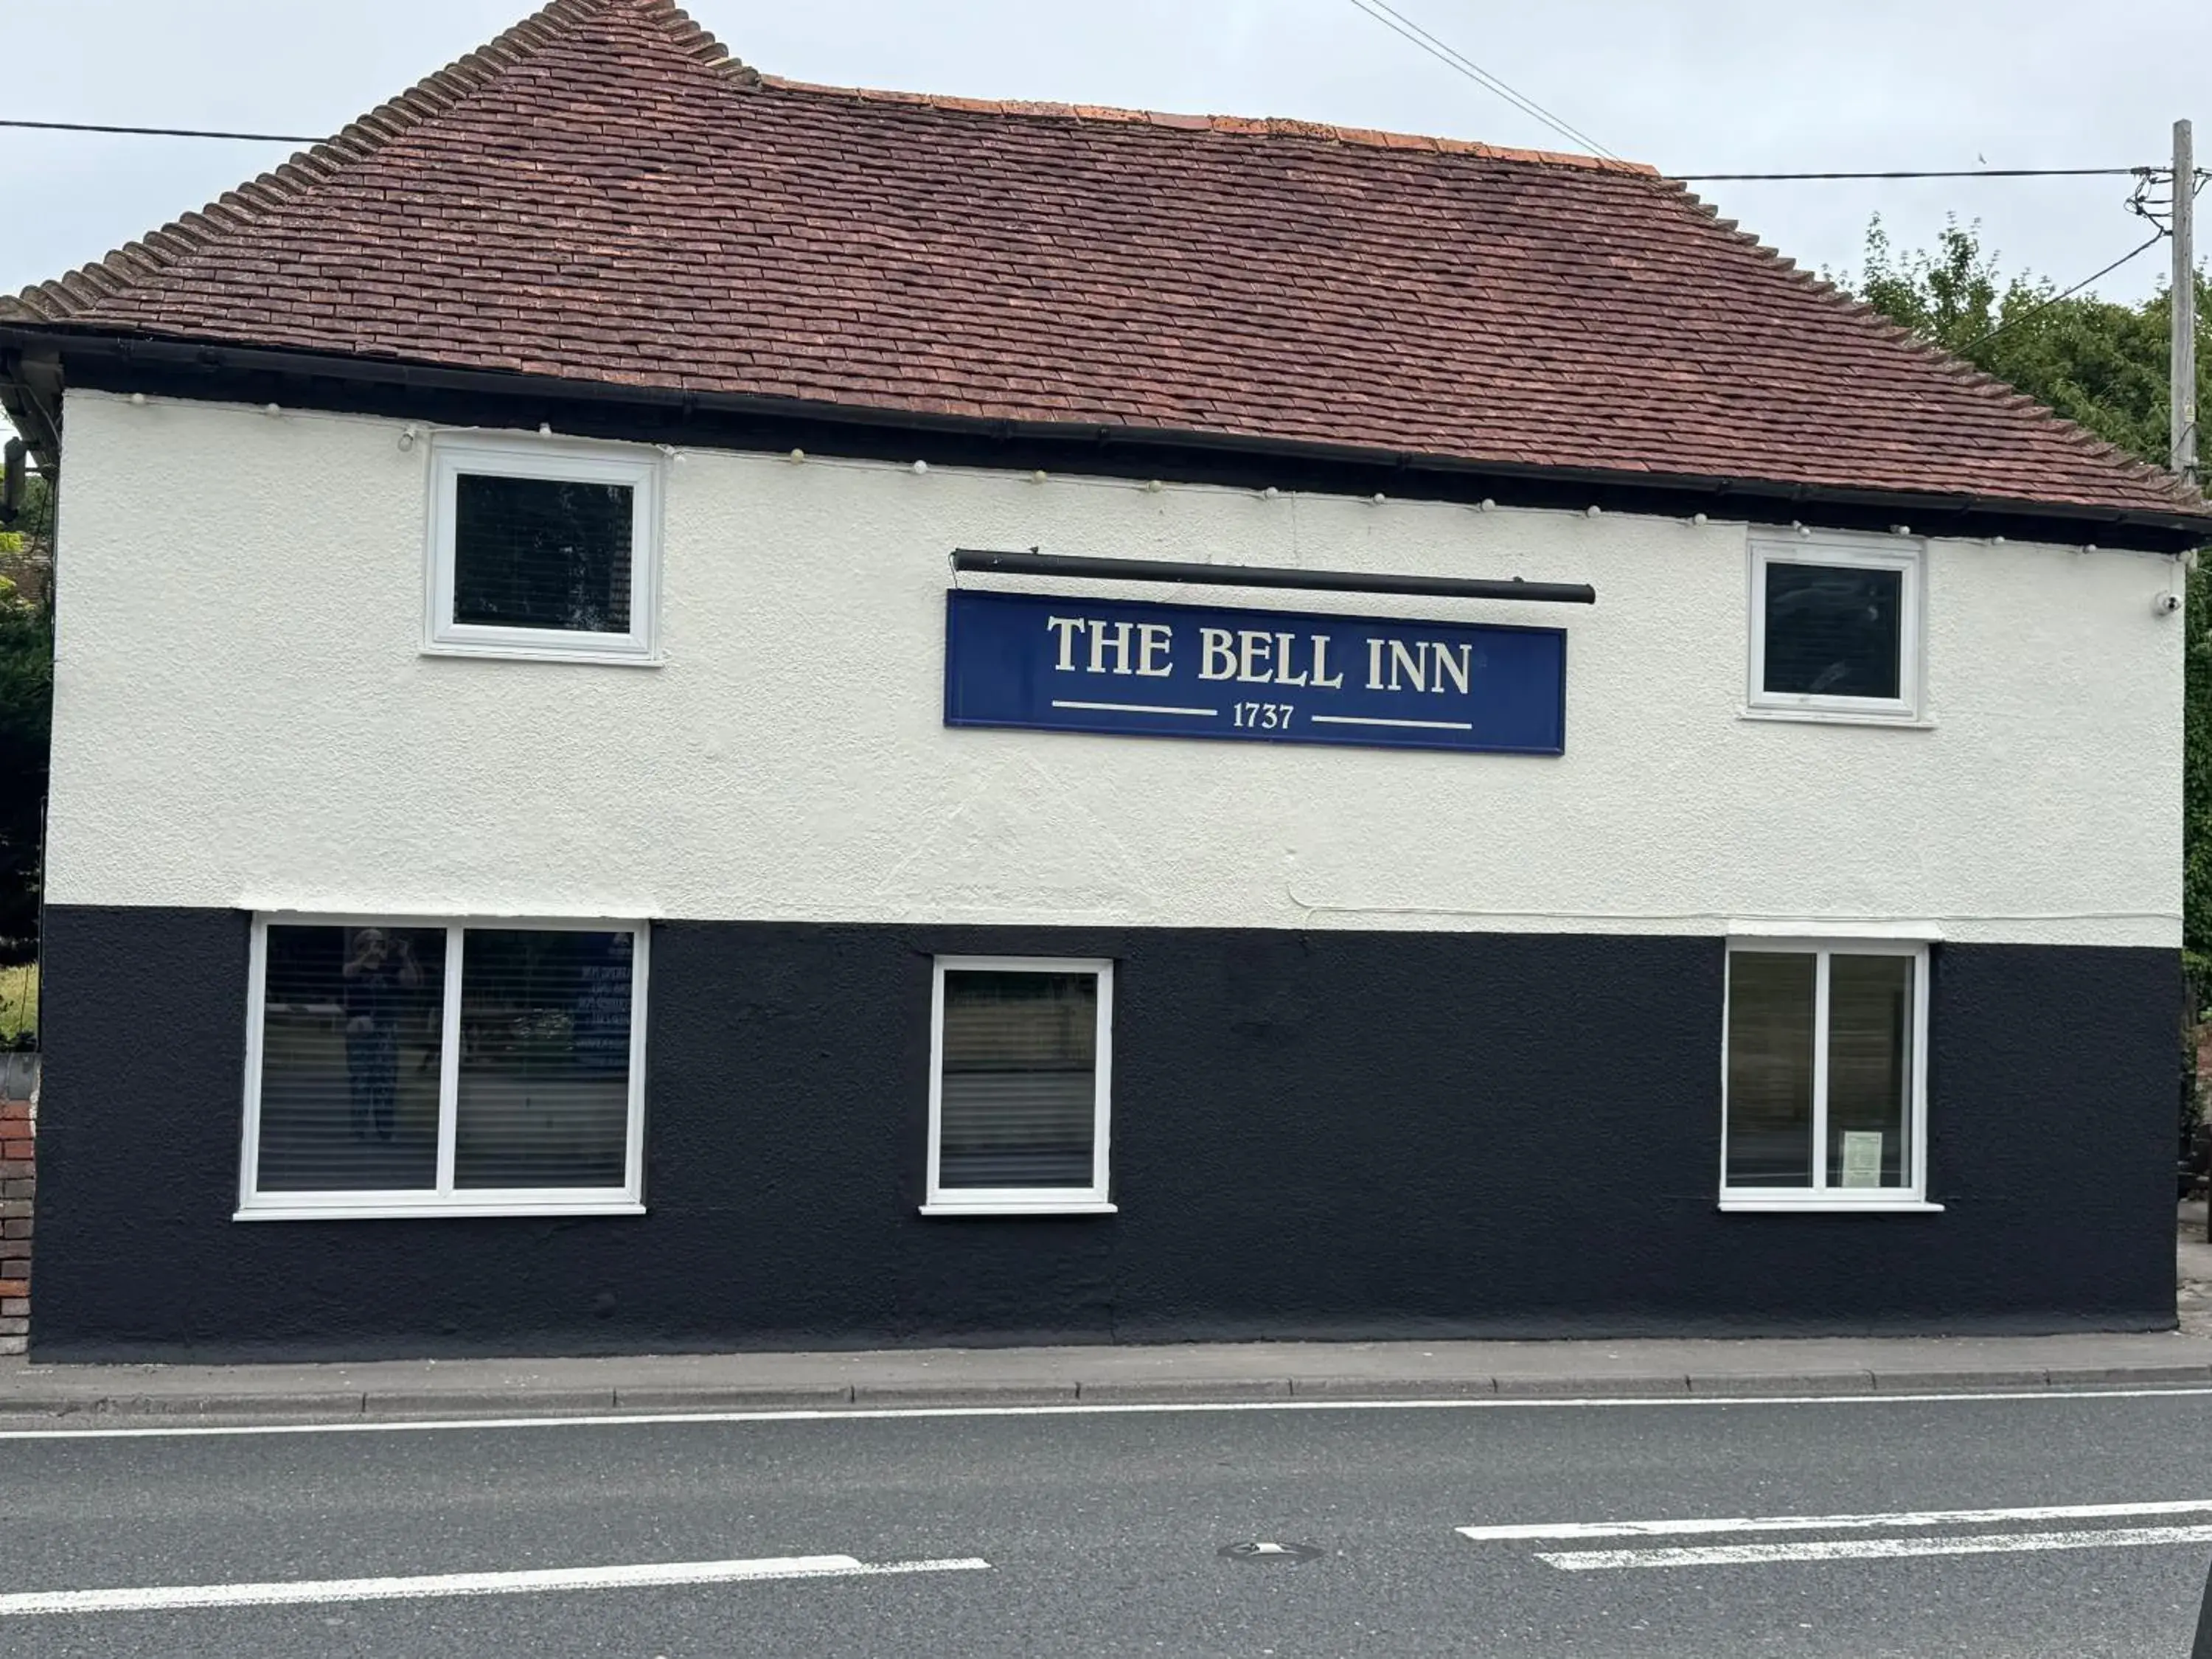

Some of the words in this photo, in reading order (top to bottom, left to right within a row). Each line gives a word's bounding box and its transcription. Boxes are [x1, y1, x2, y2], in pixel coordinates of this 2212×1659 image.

[1048, 615, 1173, 677] THE
[1198, 627, 1343, 690] BELL
[1366, 639, 1473, 695] INN
[1234, 703, 1294, 729] 1737
